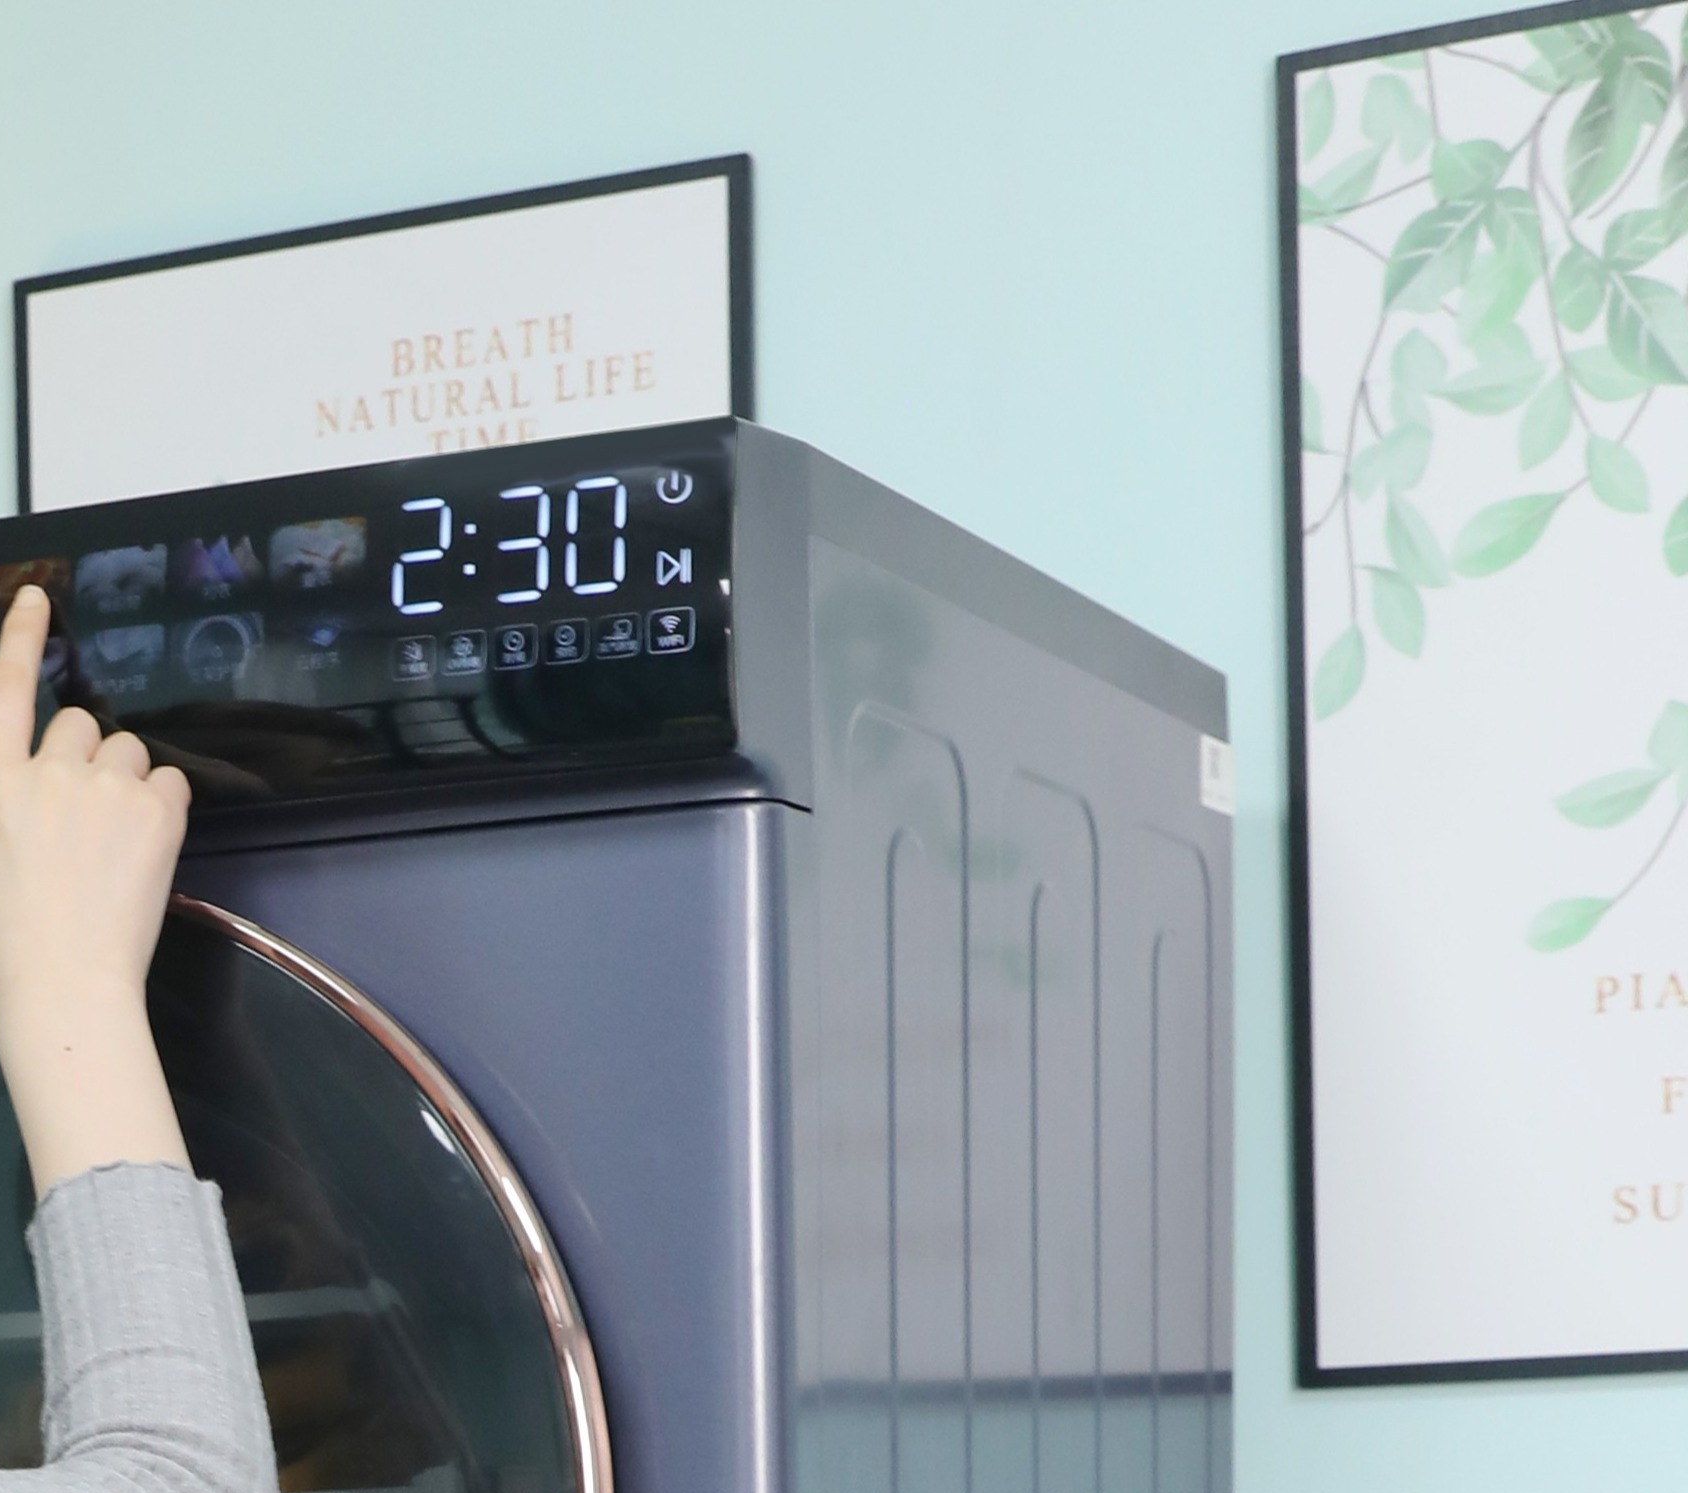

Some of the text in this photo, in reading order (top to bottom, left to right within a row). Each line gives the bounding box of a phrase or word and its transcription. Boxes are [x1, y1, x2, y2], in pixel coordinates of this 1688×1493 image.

[392, 313, 574, 378] BREATH
[316, 350, 657, 438] NATURAL LIFE
[391, 476, 627, 615] 2:30
[1612, 1182, 1686, 1225] SU
